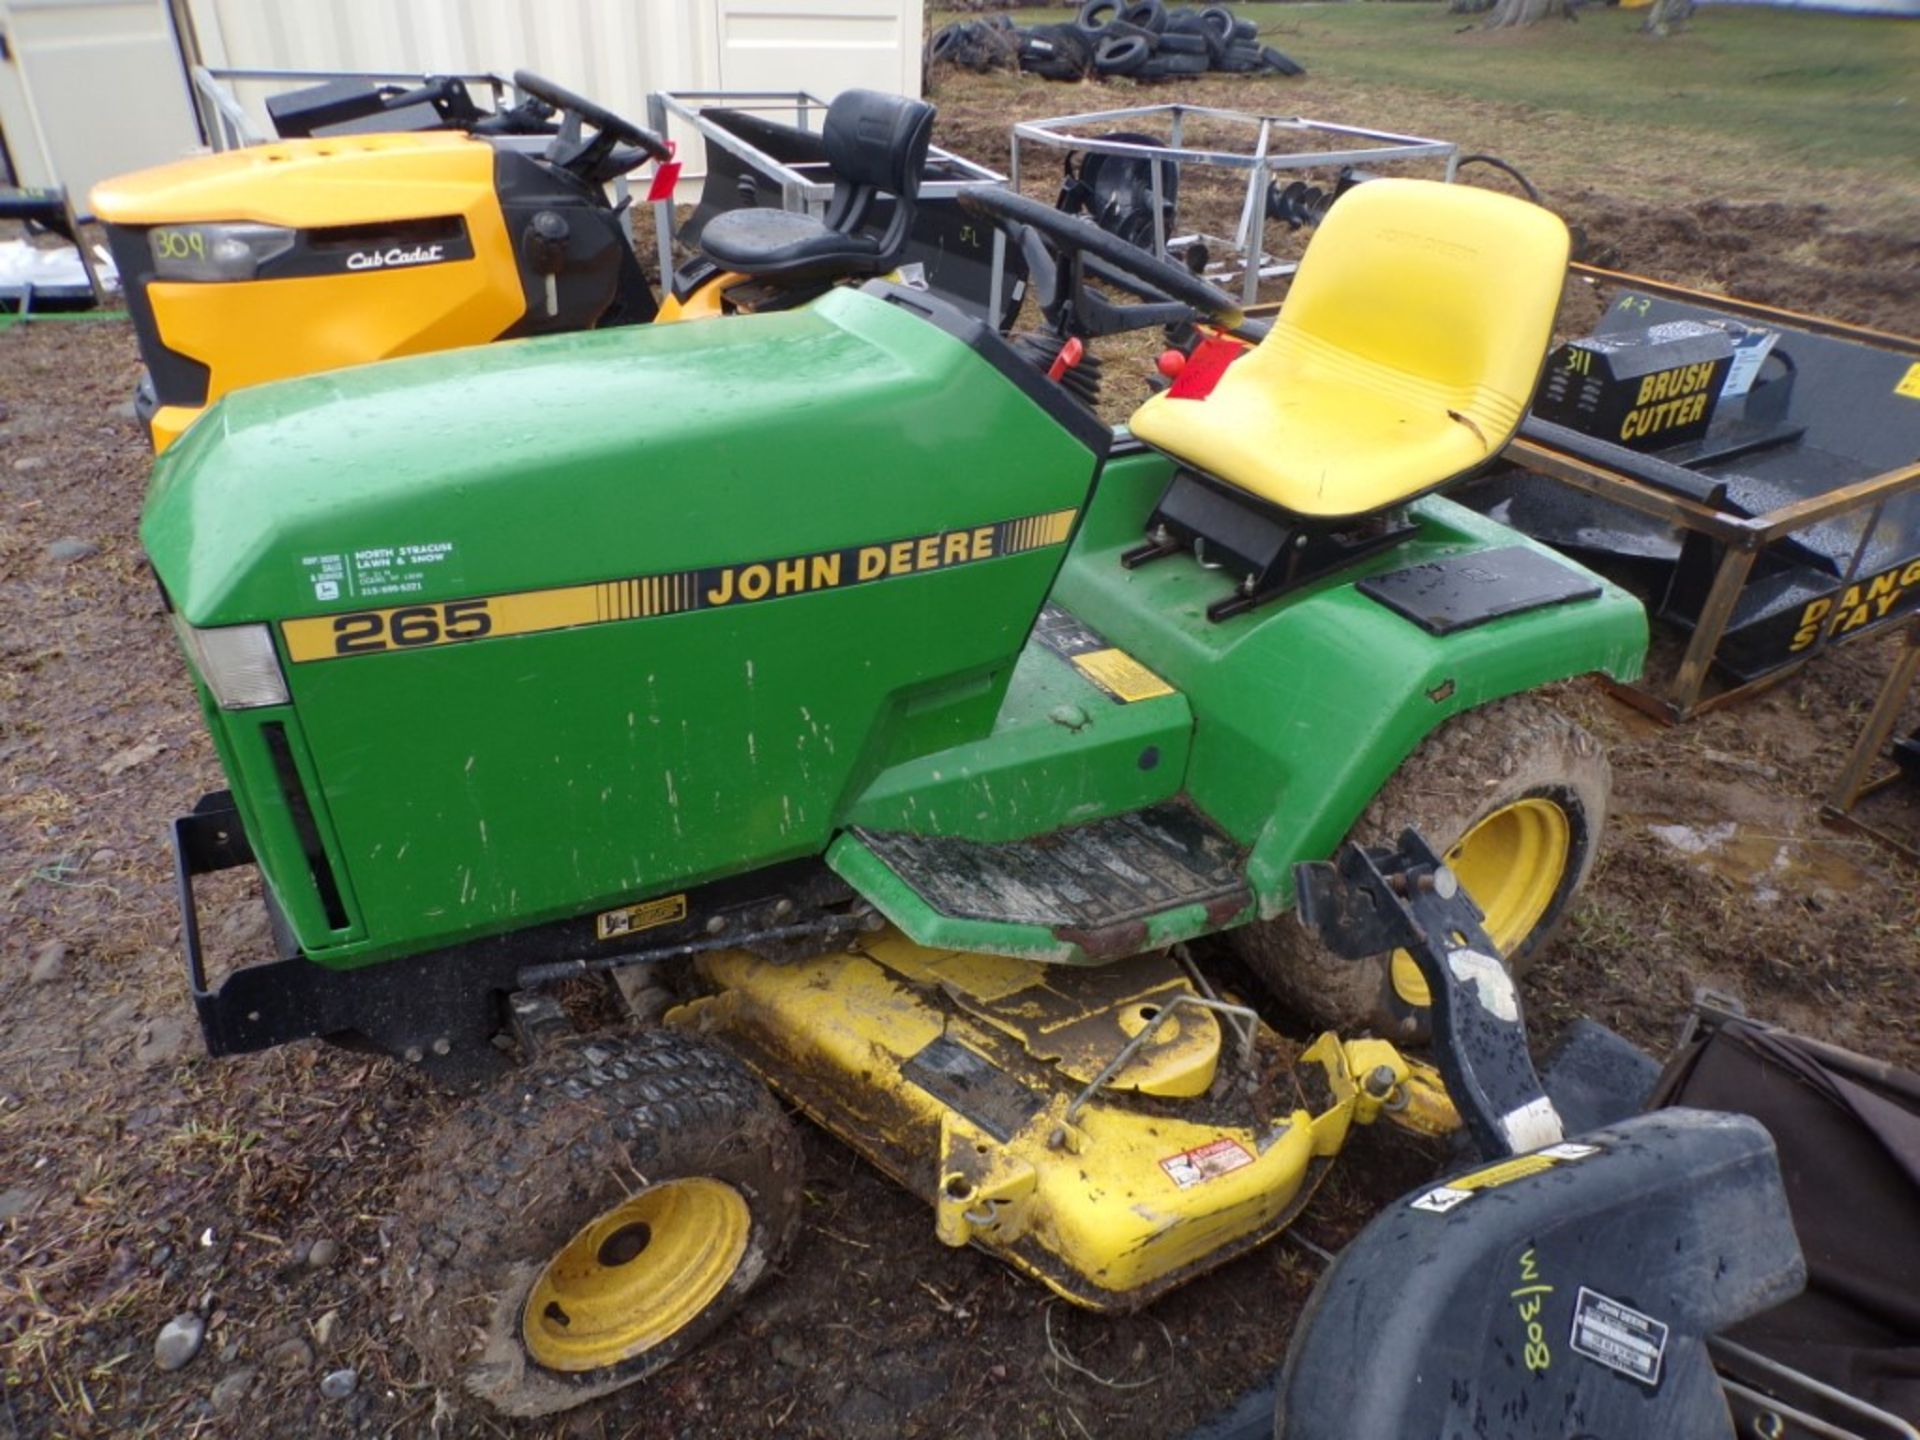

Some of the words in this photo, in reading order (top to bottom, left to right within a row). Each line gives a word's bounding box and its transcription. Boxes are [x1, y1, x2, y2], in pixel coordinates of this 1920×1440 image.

[157, 230, 205, 262] 309
[346, 251, 383, 270] Cub
[384, 246, 443, 266] Cadet
[1565, 349, 1592, 376] 311
[1636, 360, 1715, 407] BRUSH
[1620, 393, 1708, 442] CUTTER
[355, 548, 394, 560] NORTH
[357, 558, 391, 569] LAWN
[410, 553, 445, 564] SNOW
[707, 553, 842, 606] JOHN
[857, 526, 996, 582] DEERE
[333, 600, 492, 655] 265
[1789, 589, 1903, 651] STAY
